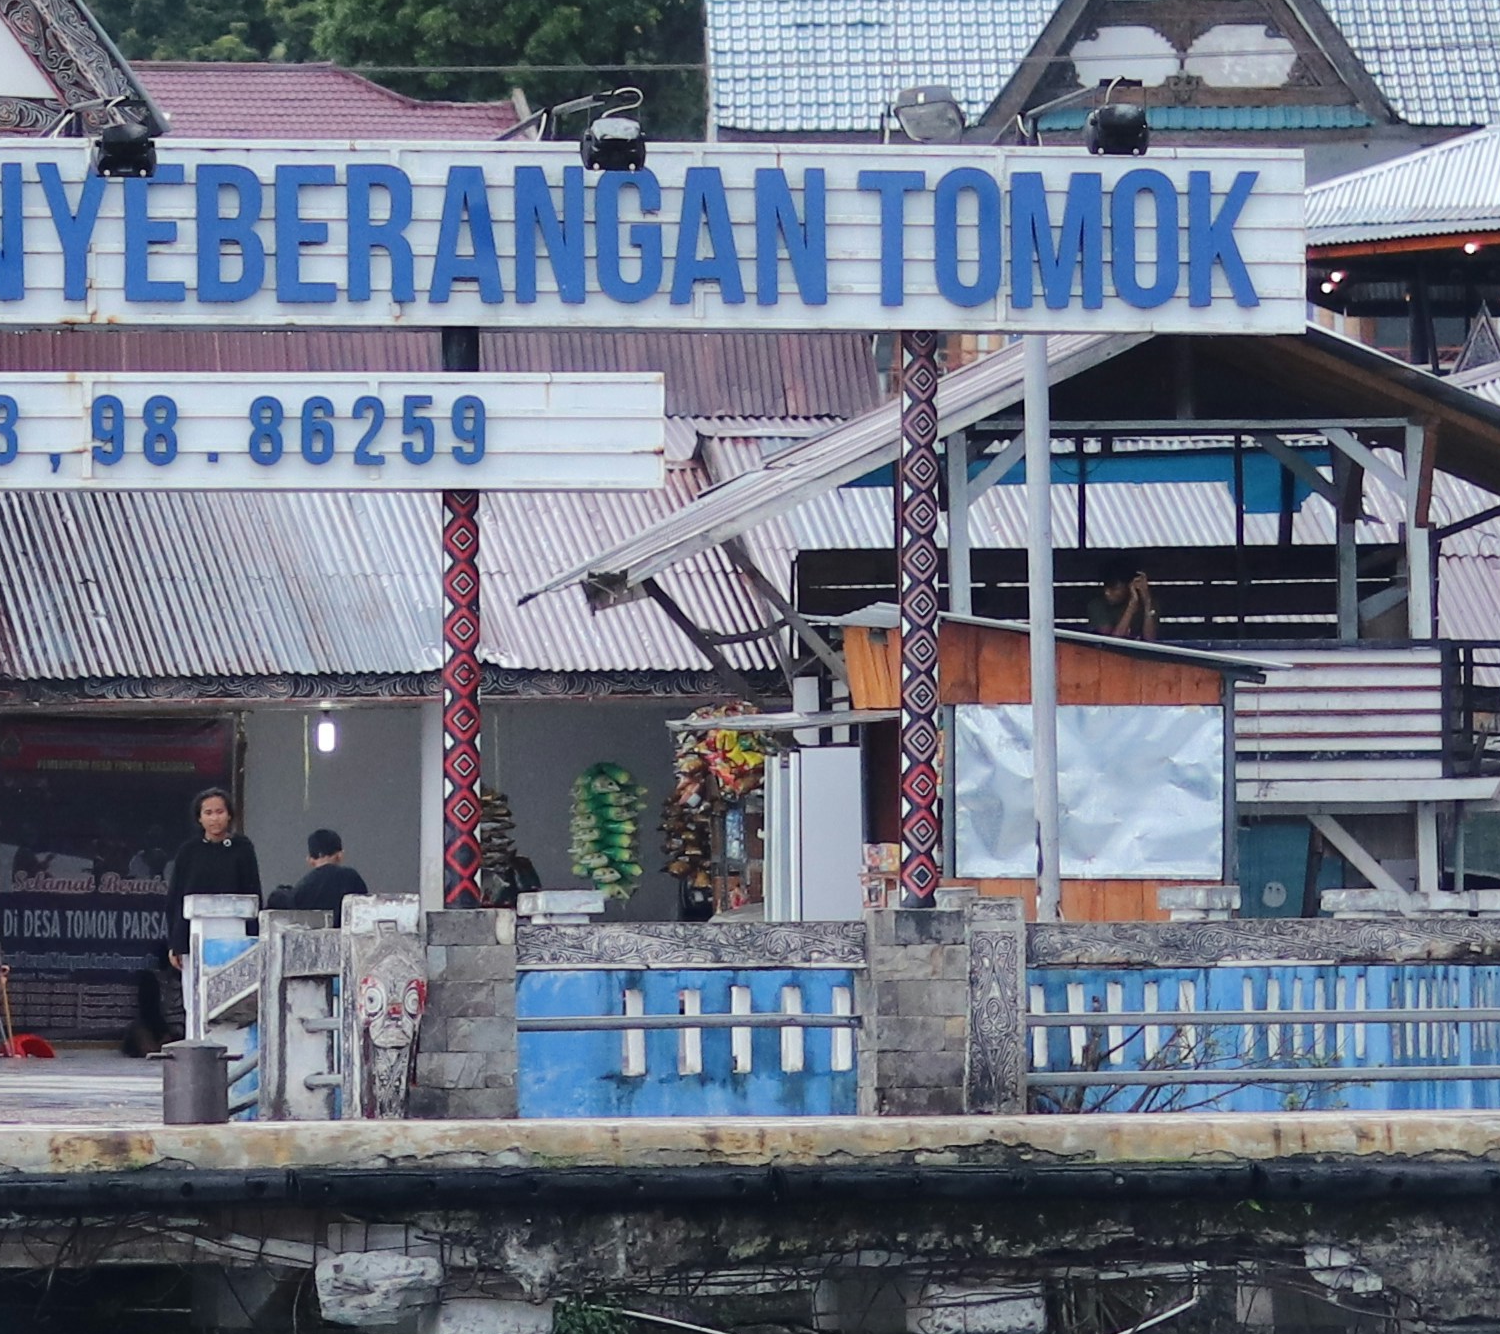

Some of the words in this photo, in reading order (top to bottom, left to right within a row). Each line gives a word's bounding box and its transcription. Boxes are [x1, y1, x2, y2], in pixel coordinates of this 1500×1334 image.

[857, 167, 1260, 309] TOMOK
[13, 870, 96, 893] Selamat
[3, 908, 18, 937] Di
[24, 909, 61, 938] DESA
[65, 910, 117, 939] TOMOK
